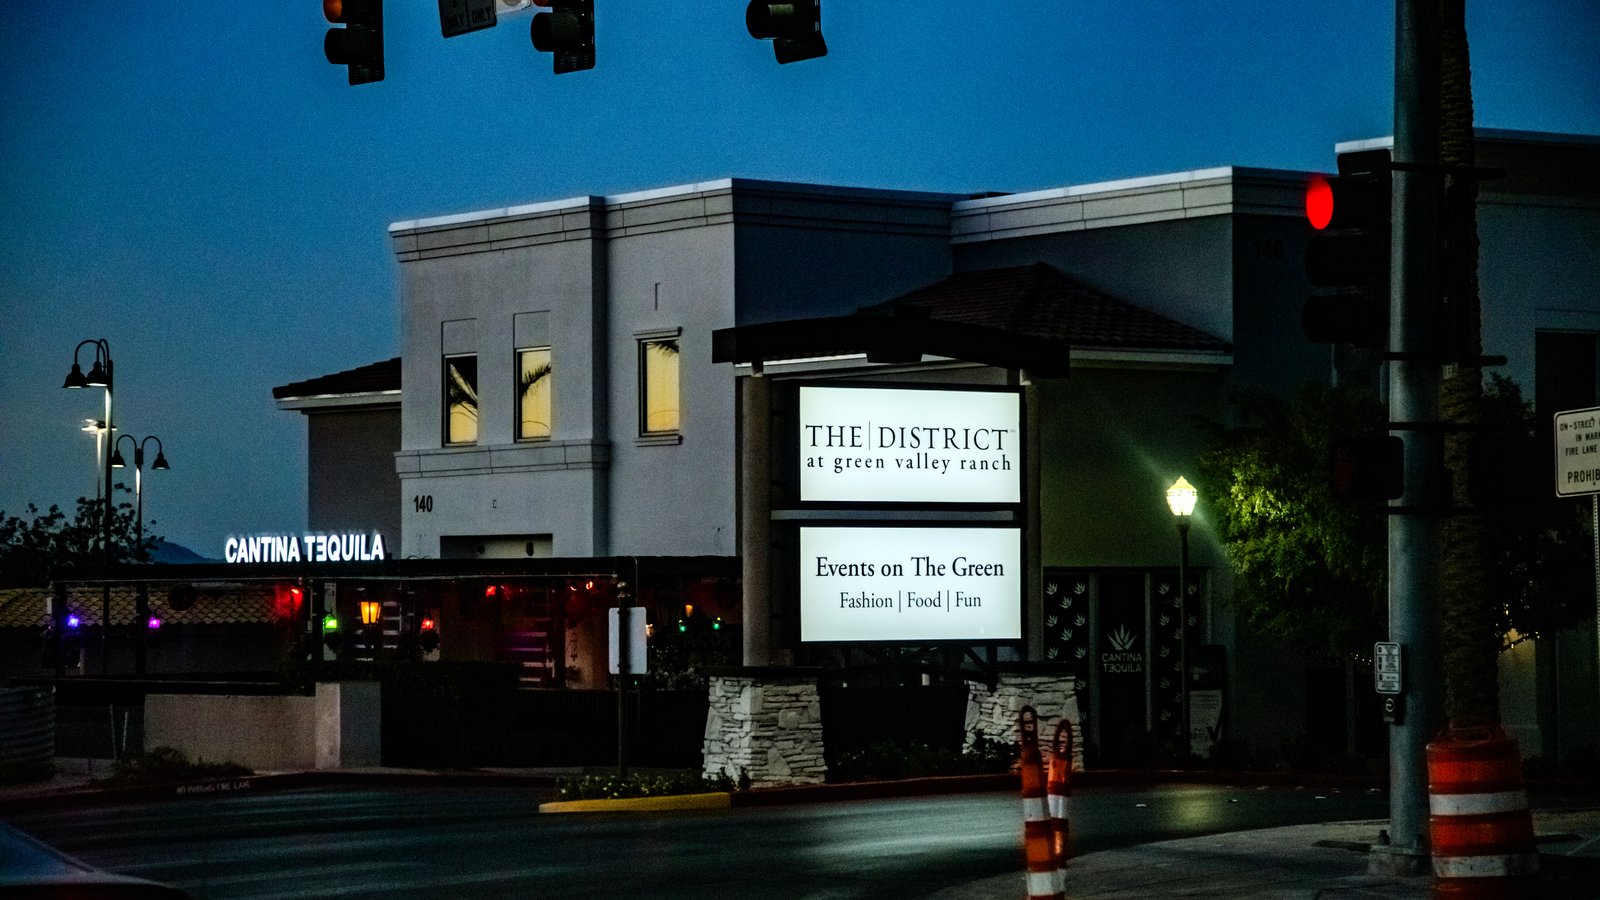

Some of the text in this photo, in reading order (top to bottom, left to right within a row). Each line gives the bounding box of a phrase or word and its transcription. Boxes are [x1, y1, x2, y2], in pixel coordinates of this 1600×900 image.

[471, 7, 491, 23] ONLY
[805, 424, 1008, 451] THE DISTRICT
[1566, 445, 1597, 456] FIRE LANE
[807, 453, 1011, 474] at green valley ranch
[413, 495, 433, 512] 140
[225, 536, 301, 563] CANTINA
[815, 556, 1005, 576] Events on The Green
[839, 591, 982, 608] Fashion Food Fun
[1101, 653, 1143, 662] CANTINA
